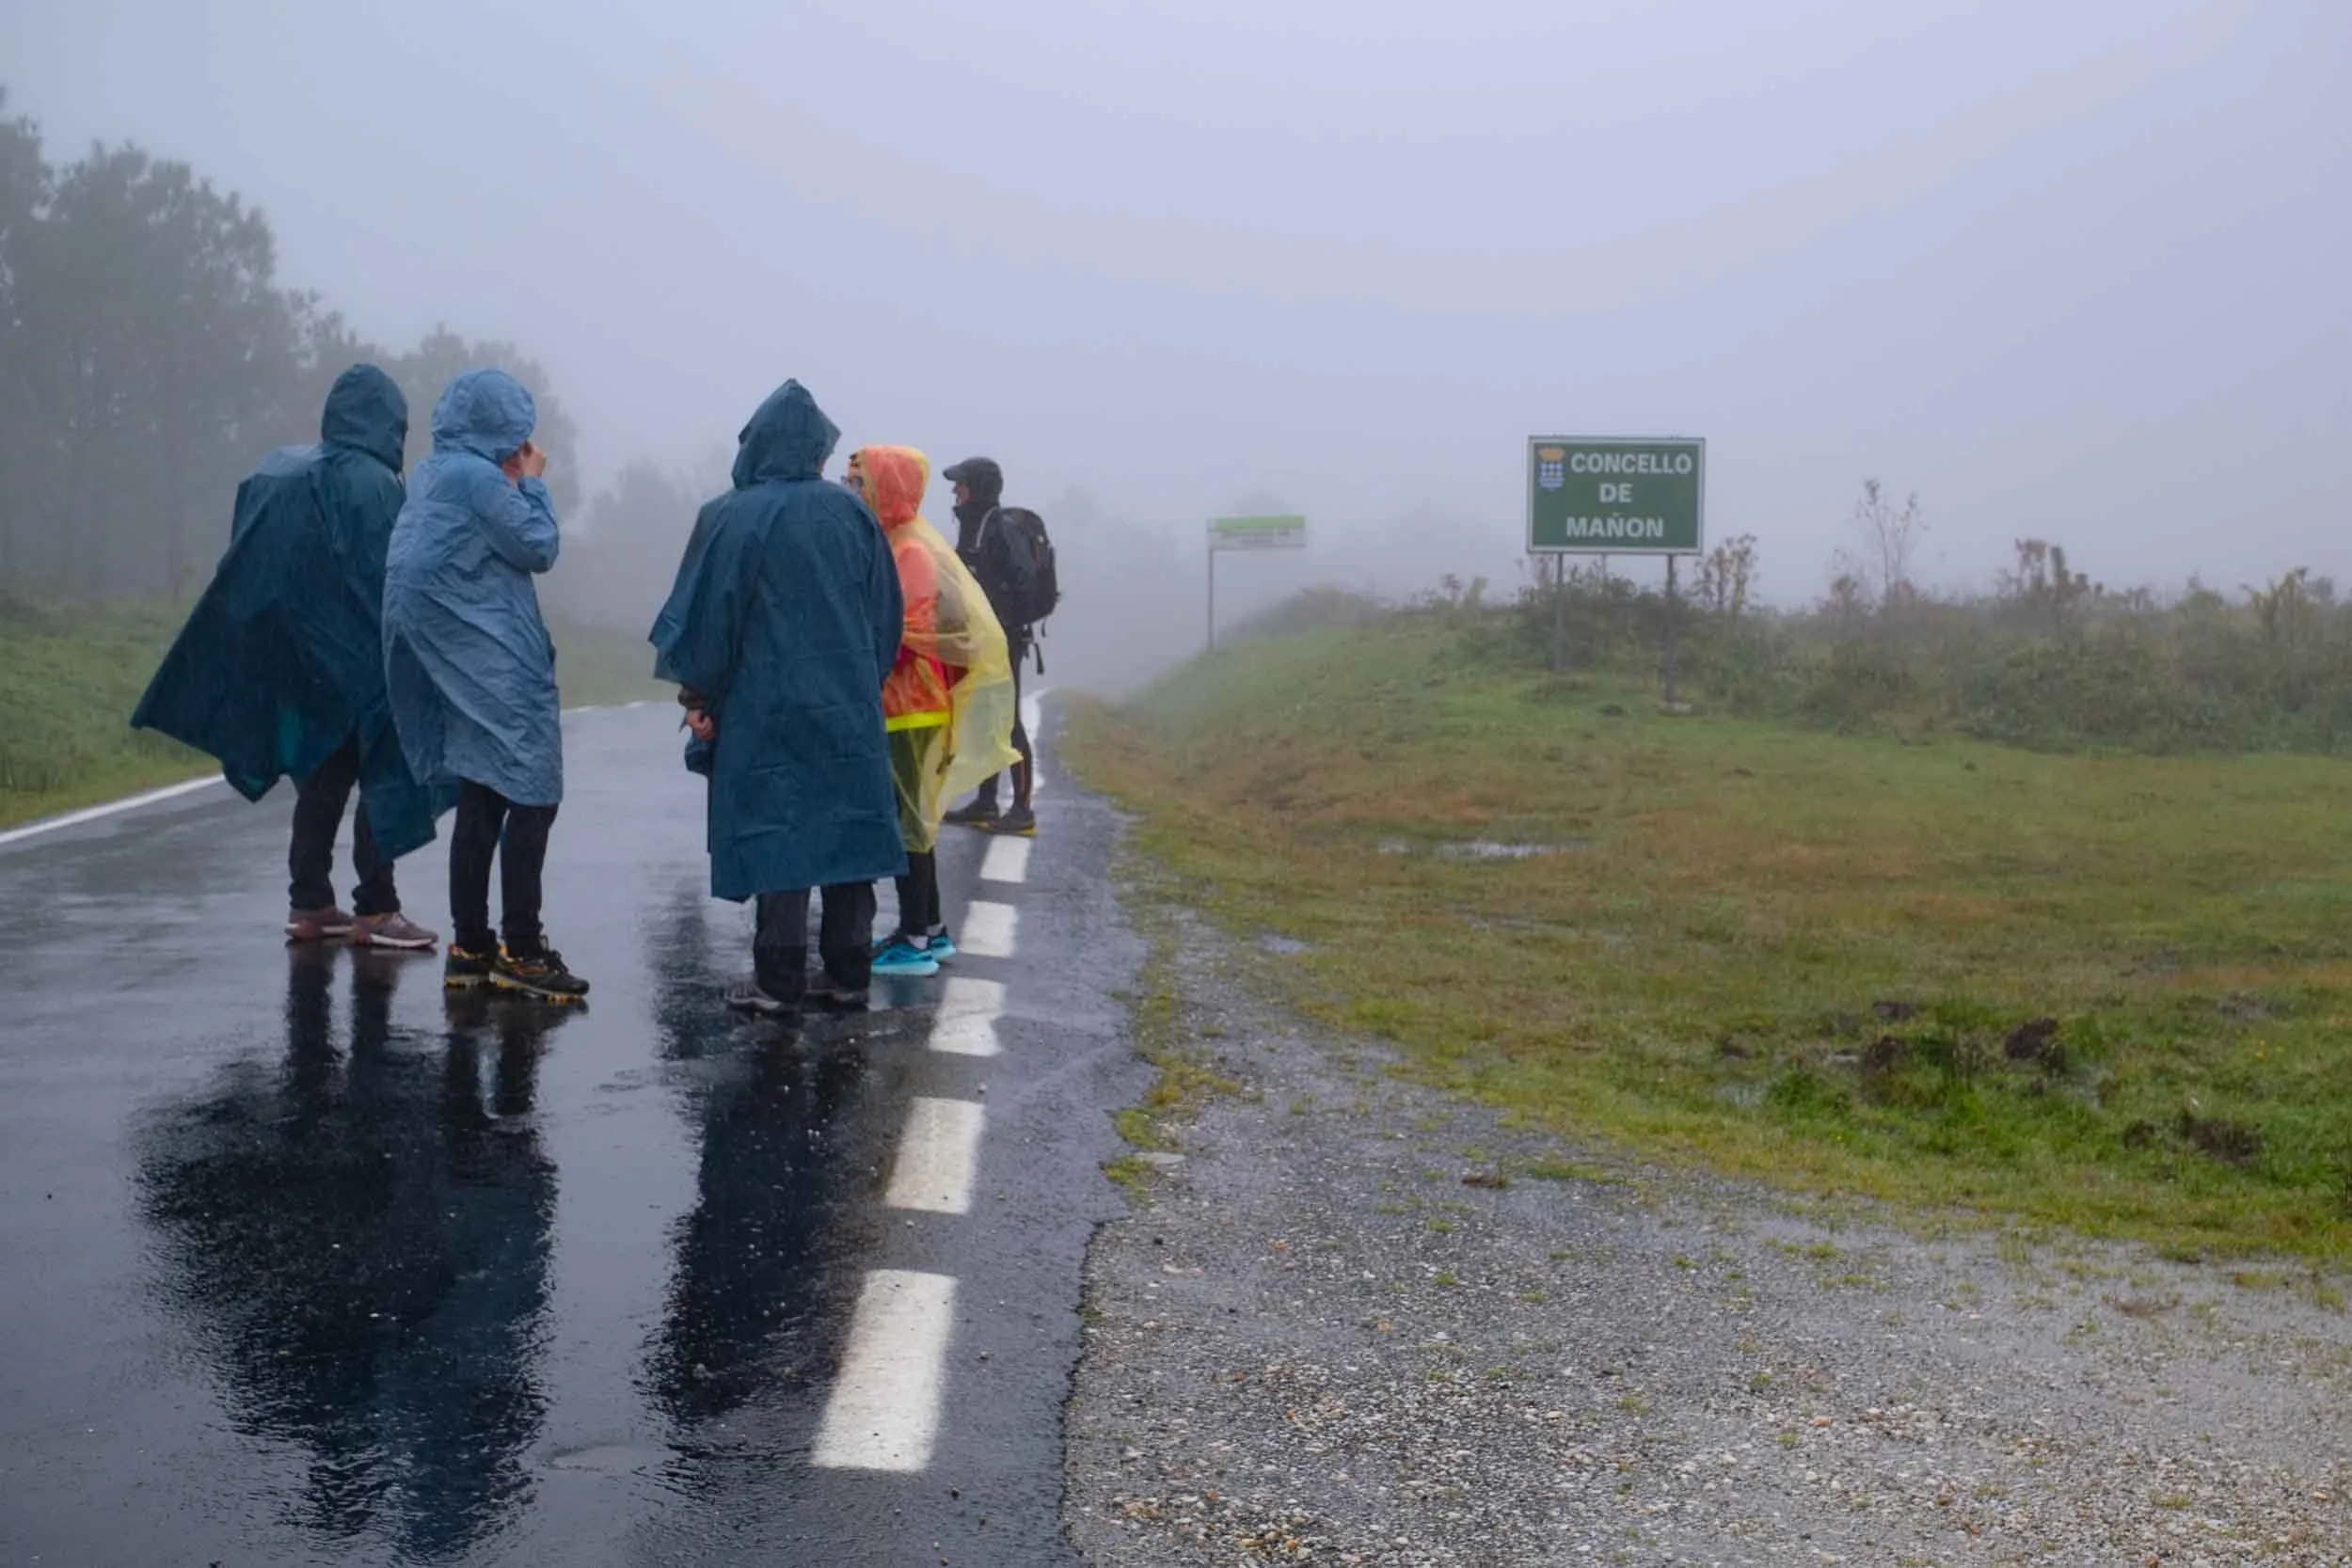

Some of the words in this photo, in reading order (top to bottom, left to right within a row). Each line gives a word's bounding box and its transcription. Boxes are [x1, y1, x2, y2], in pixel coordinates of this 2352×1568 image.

[1570, 452, 1692, 474] CONCELLO
[1599, 483, 1633, 502] DE
[1565, 512, 1663, 538] MAÑON
